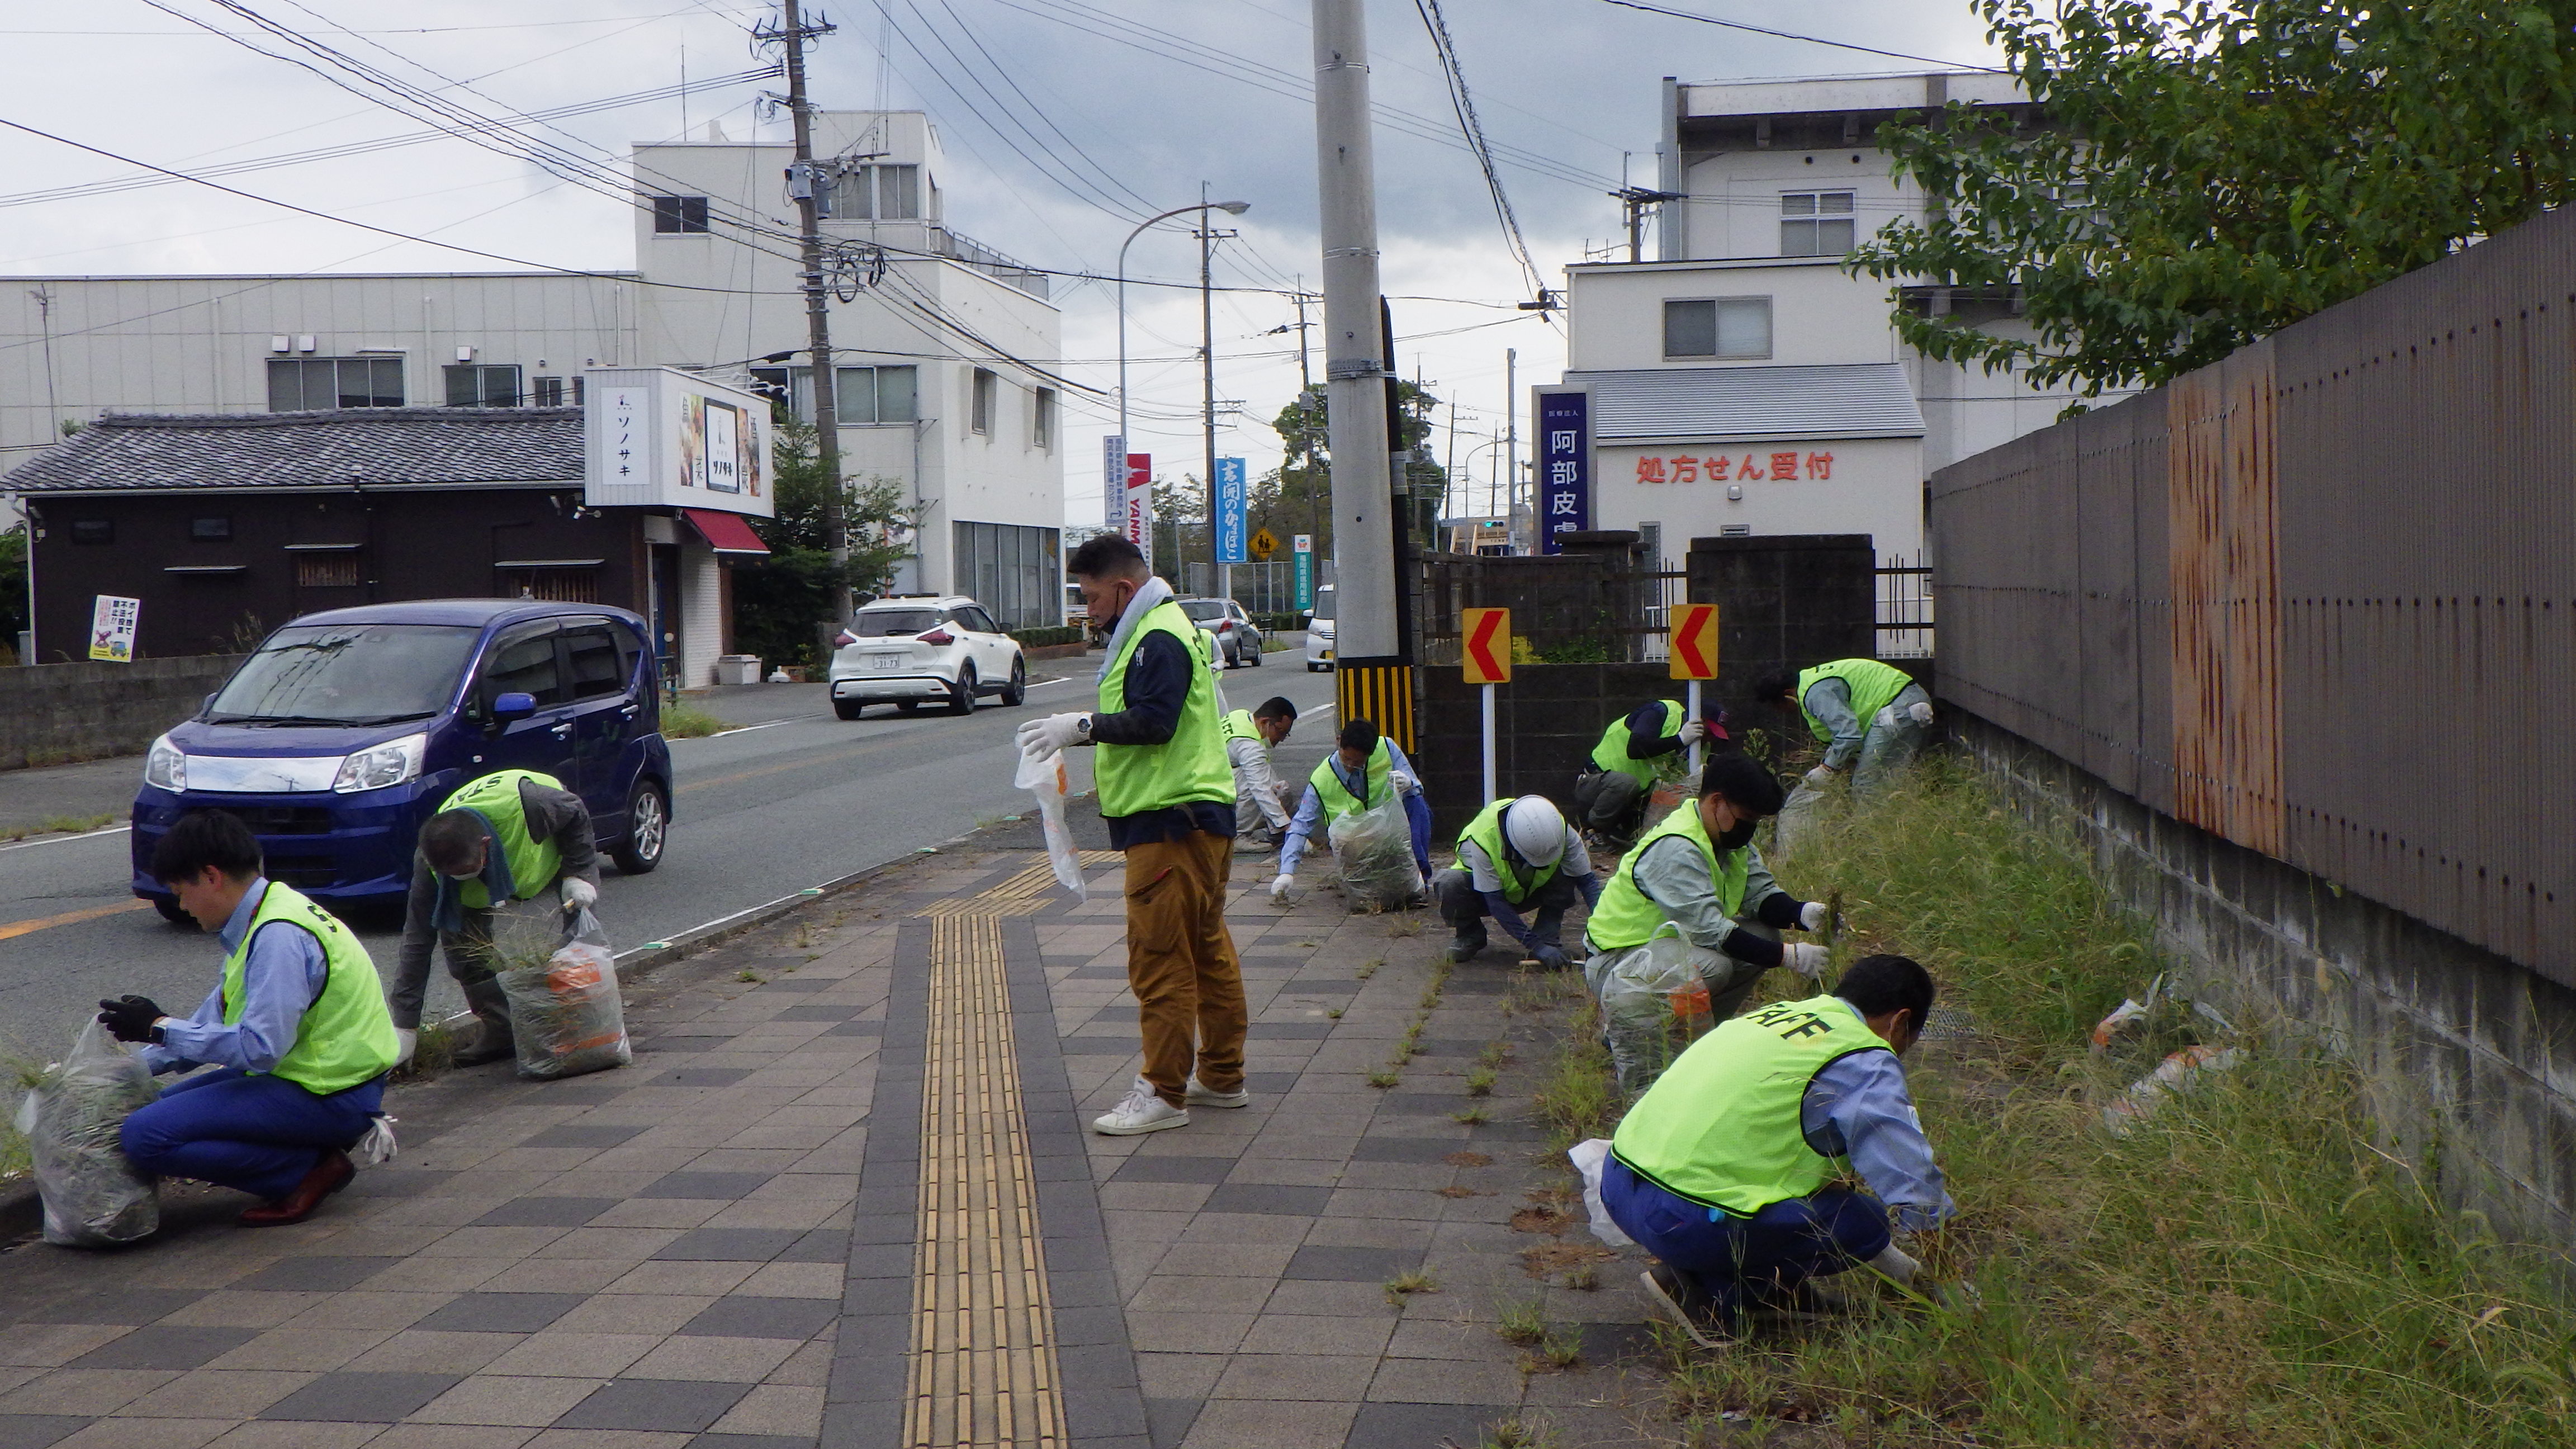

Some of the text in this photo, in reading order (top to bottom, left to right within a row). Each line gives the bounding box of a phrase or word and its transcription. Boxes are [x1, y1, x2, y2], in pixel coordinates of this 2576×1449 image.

[618, 416, 631, 477] ソノサキ
[1636, 451, 1834, 484] 処方せん受付
[1129, 498, 1141, 544] YANM
